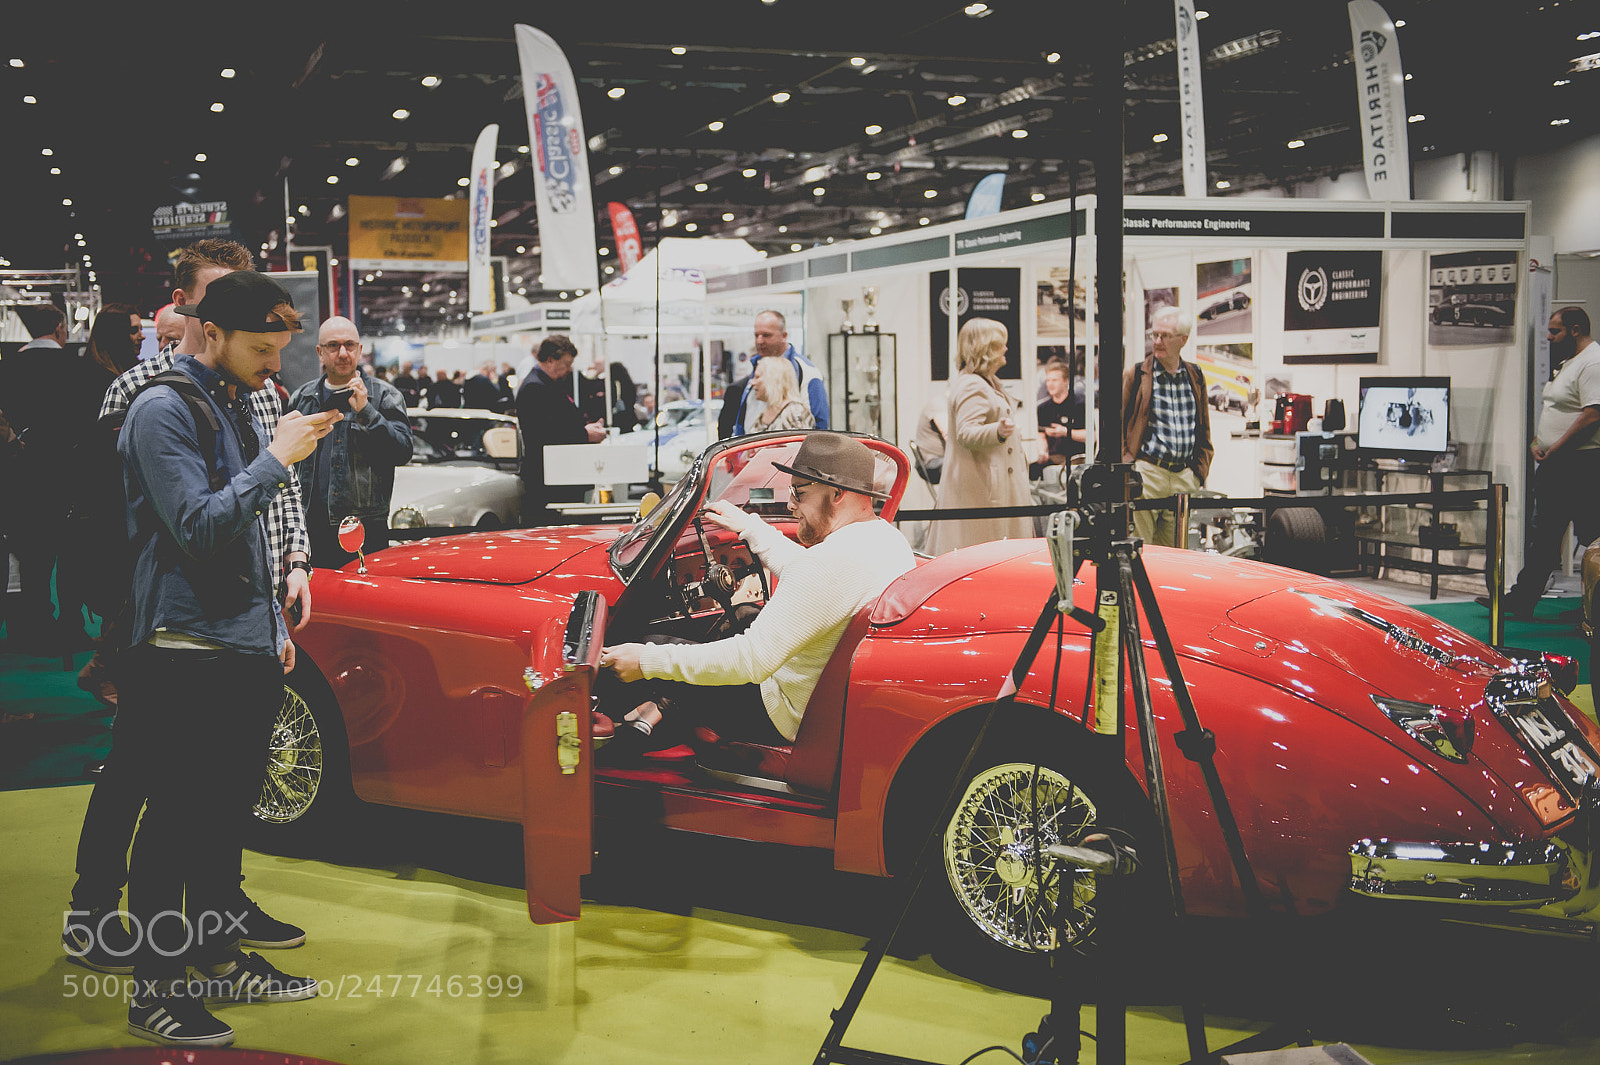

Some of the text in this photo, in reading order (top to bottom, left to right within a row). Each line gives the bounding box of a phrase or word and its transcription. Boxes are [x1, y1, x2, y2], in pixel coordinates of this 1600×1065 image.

[1123, 218, 1251, 231] Classic Performance Engineering
[1331, 269, 1355, 280] CLASSIC
[1331, 279, 1371, 290] PERFORMANCE
[1331, 289, 1368, 301] ENGINEERING
[1454, 307, 1461, 320] 5
[1516, 709, 1566, 750] NSL
